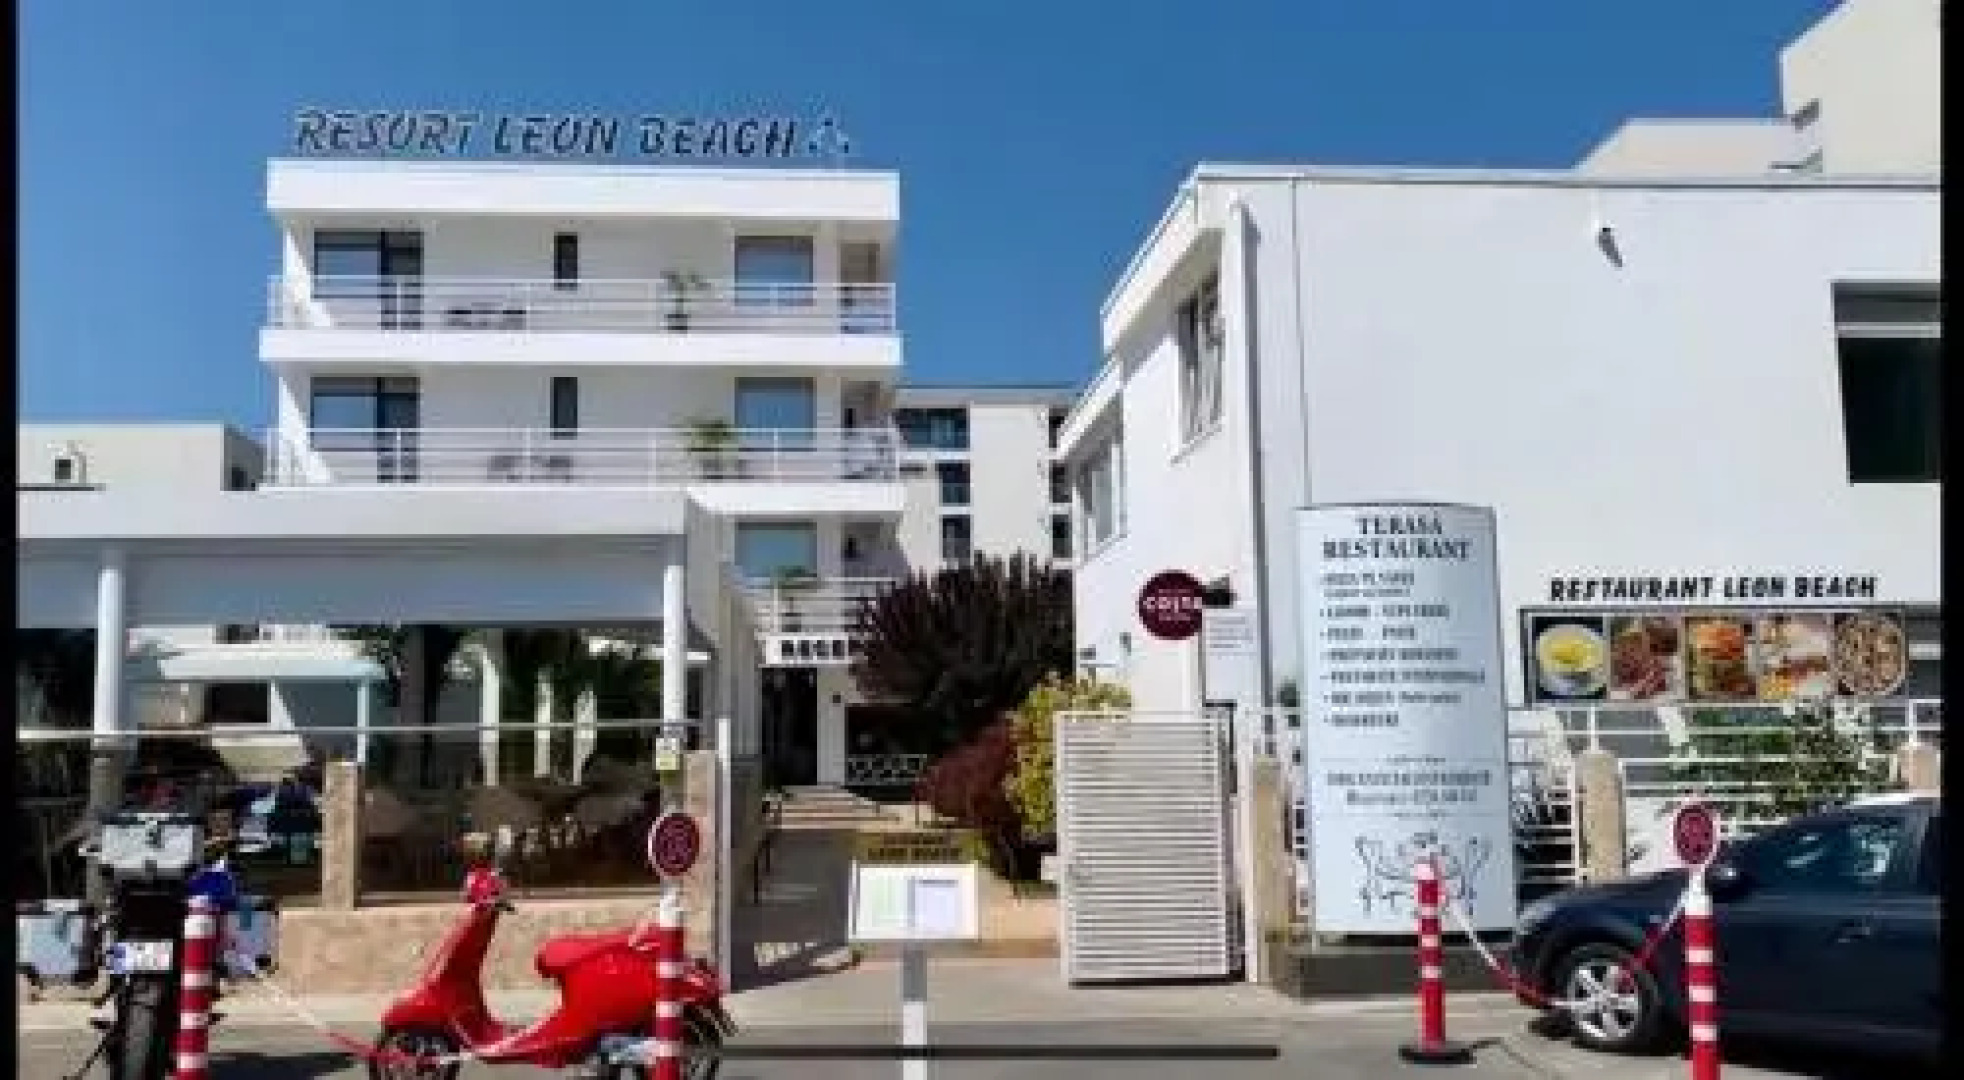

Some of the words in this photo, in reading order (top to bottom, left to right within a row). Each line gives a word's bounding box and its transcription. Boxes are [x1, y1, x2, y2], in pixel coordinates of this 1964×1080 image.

[293, 109, 480, 153] RESORT
[492, 115, 622, 155] LEON
[637, 117, 799, 158] BEACH
[1322, 537, 1474, 559] RESTAURANT
[1550, 577, 1714, 599] RESTAURANT
[1723, 577, 1785, 598] LEON
[1793, 576, 1877, 598] BEACH
